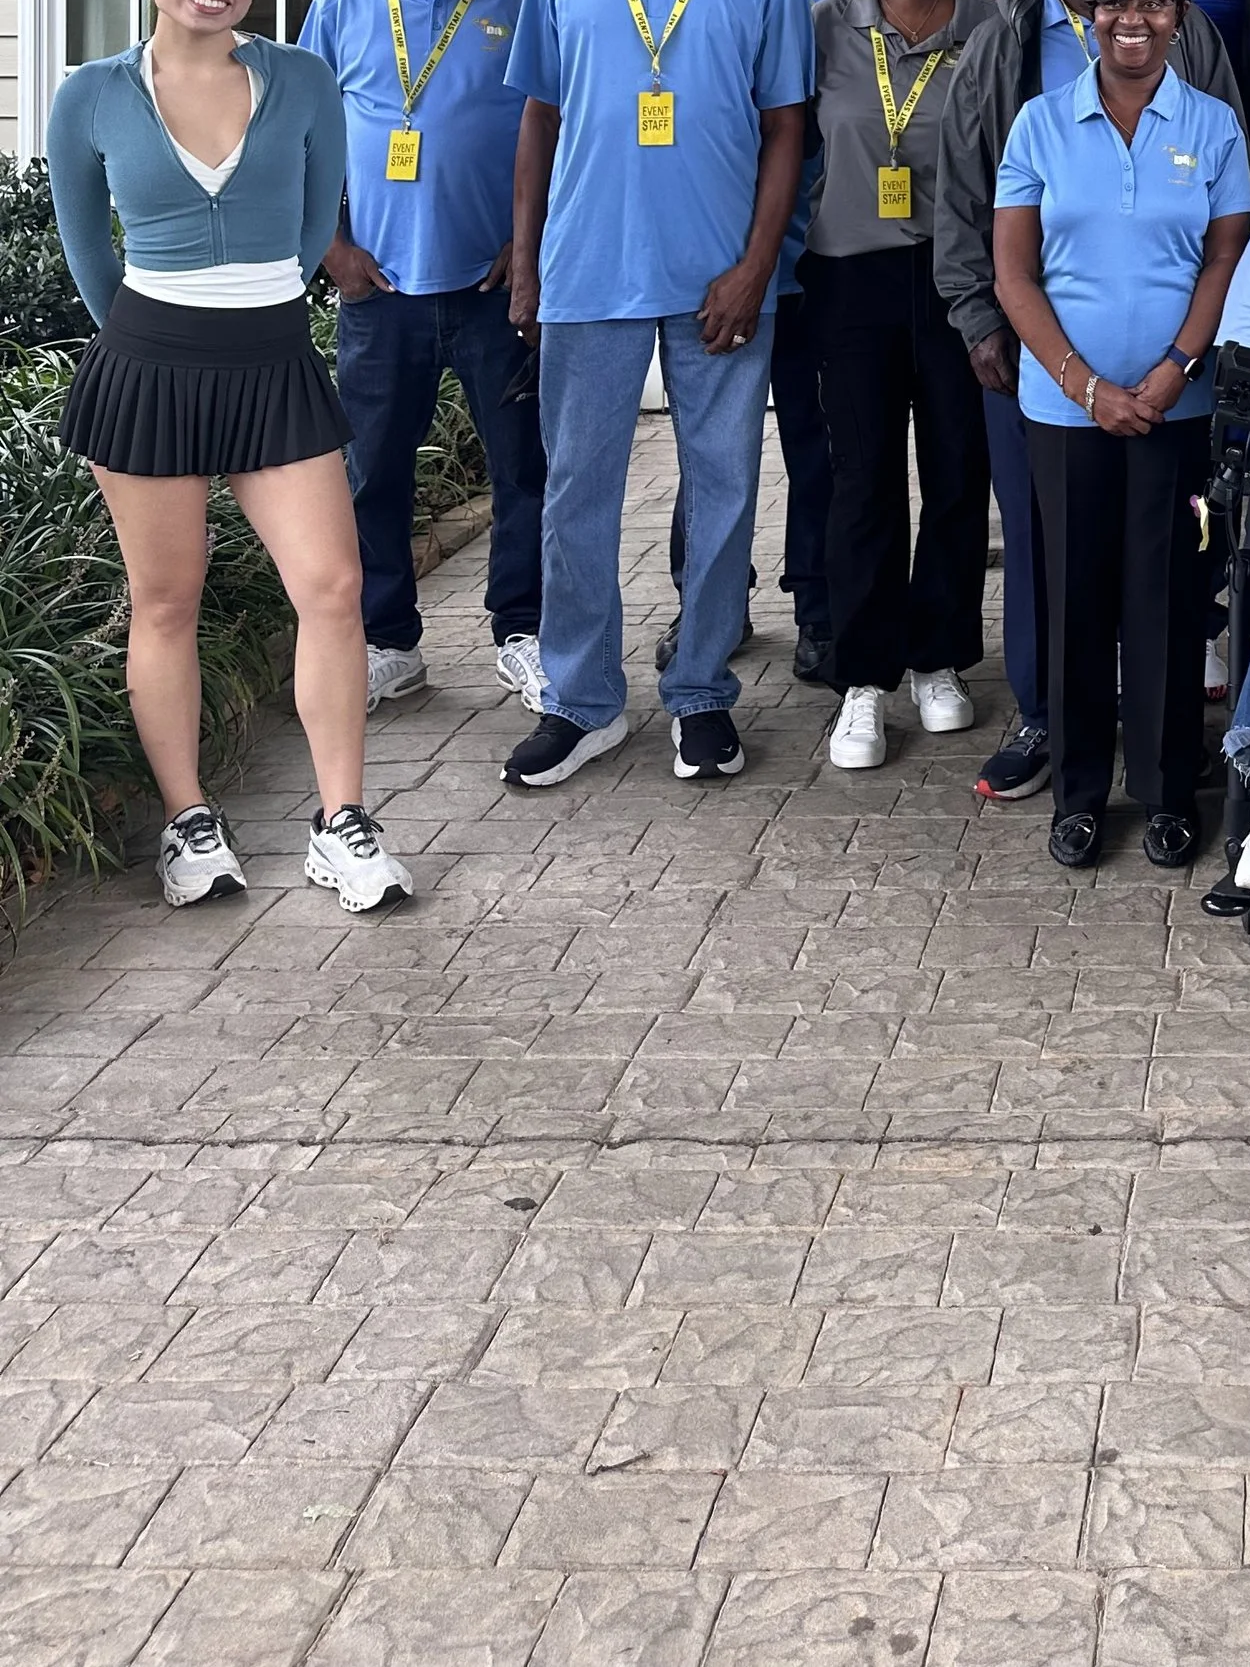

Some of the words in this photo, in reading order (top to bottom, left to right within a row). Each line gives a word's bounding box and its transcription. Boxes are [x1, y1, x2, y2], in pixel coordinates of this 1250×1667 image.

[392, 8, 400, 27] EVENT
[636, 12, 648, 34] EVENT
[395, 29, 404, 48] STAFF
[438, 32, 451, 51] EVENT
[449, 11, 462, 32] STAFF
[875, 37, 884, 57] EVENT
[399, 58, 407, 75] EVENT
[422, 59, 436, 80] STAFF
[877, 57, 886, 75] STAFF
[919, 62, 932, 82] EVENT
[882, 85, 893, 107] EVENT
[642, 105, 669, 116] EVENT
[893, 113, 907, 135] EVENT
[904, 91, 918, 112] STAFF
[641, 119, 669, 131] STAFF
[392, 143, 416, 153] EVENT
[390, 155, 414, 167] STAFF
[882, 180, 907, 190] EVENT
[882, 193, 907, 204] STAFF
